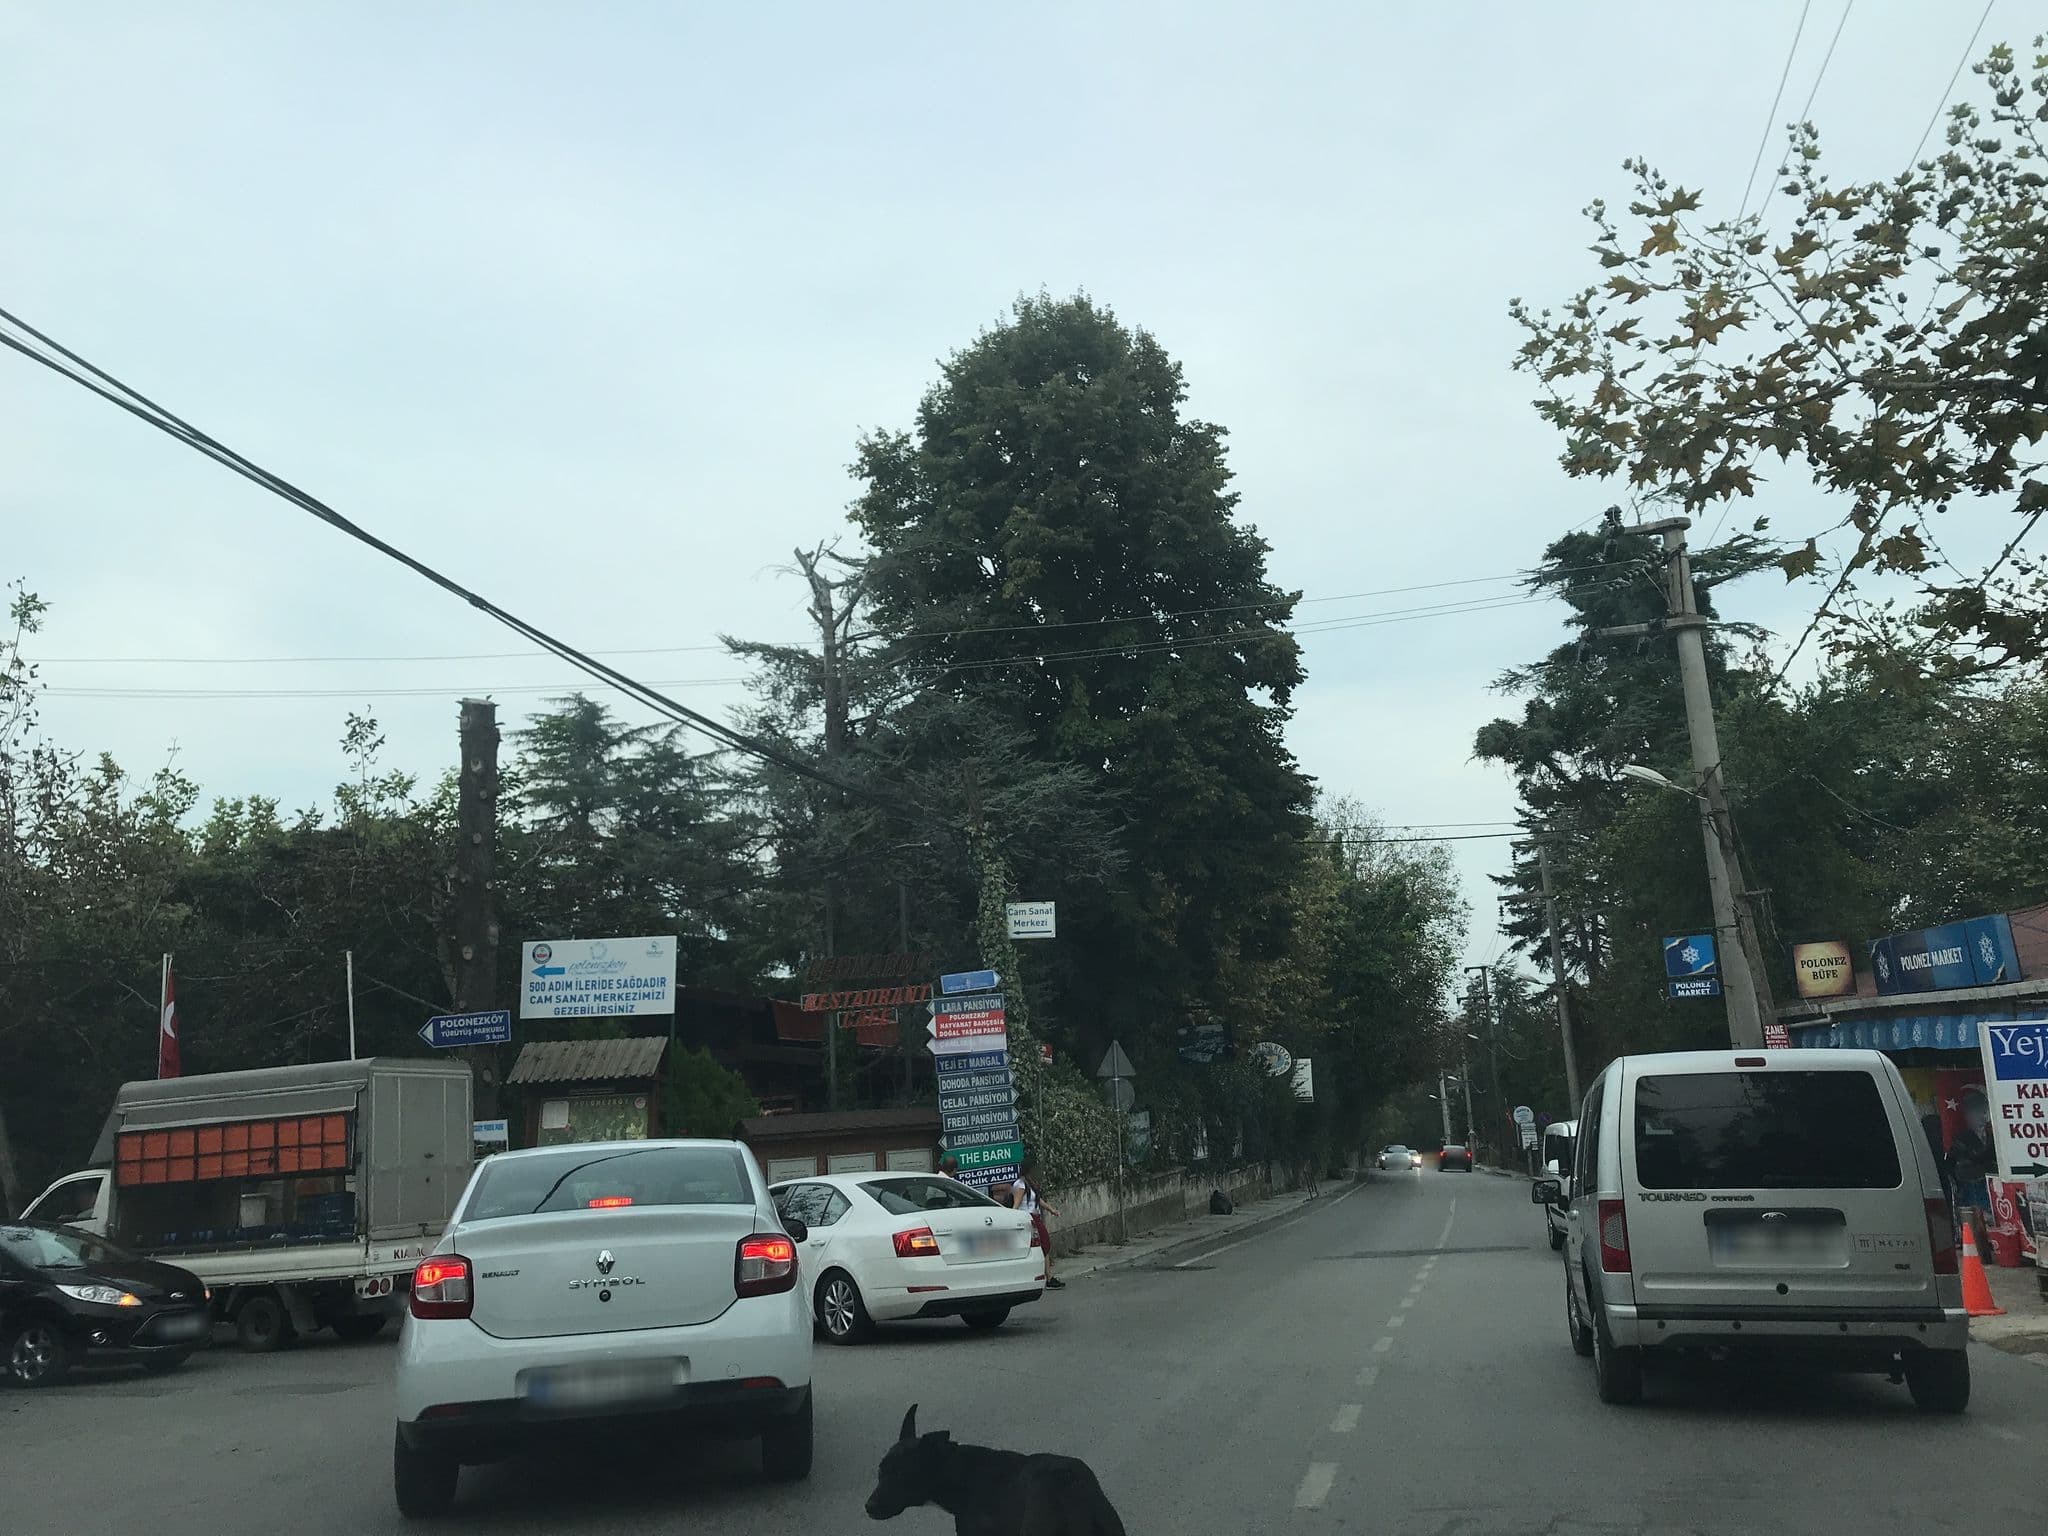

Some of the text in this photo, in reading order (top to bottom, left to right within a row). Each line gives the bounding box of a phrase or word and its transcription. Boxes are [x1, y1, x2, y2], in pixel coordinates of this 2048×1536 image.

[1008, 907, 1052, 916] Cam Sanat
[1014, 919, 1048, 928] Merkezi
[1800, 956, 1847, 968] POLONEZ
[1900, 946, 1964, 972] POLONEZ MARKET
[1812, 968, 1839, 980] BÜFE
[529, 975, 667, 992] 500 ADIM İLERİDE SAĞDADIR
[1676, 981, 1711, 990] POLONEZ
[530, 990, 666, 1005] CAM SANAT MERKEZİMİZİ
[804, 982, 931, 1011] RESTAURANT
[1678, 988, 1711, 996] MARKET
[554, 1004, 636, 1016] GEZEBİLİRSİNİZ
[941, 998, 1000, 1012] LARA PANSİYON
[440, 1014, 504, 1028] POLONEZKÖY
[939, 1029, 960, 1037] DOĞAL
[1990, 1028, 2048, 1066] Yej
[958, 1060, 968, 1070] ET
[968, 1056, 1001, 1068] MANGAL
[972, 1074, 1006, 1089] PANSİYON
[942, 1091, 1008, 1109] CELAL PANSİYON
[2002, 1103, 2045, 1119] ET &
[947, 1110, 1008, 1128] FREDİ PANSİYON
[953, 1129, 1014, 1146] LEONARDO HAVUZ
[960, 1148, 1012, 1164] THE BARN
[958, 1166, 1014, 1180] POLGARDEN
[990, 1173, 1018, 1184] ALANI
[481, 1269, 520, 1279] RENAULT
[568, 1276, 646, 1290] SYMBOL
